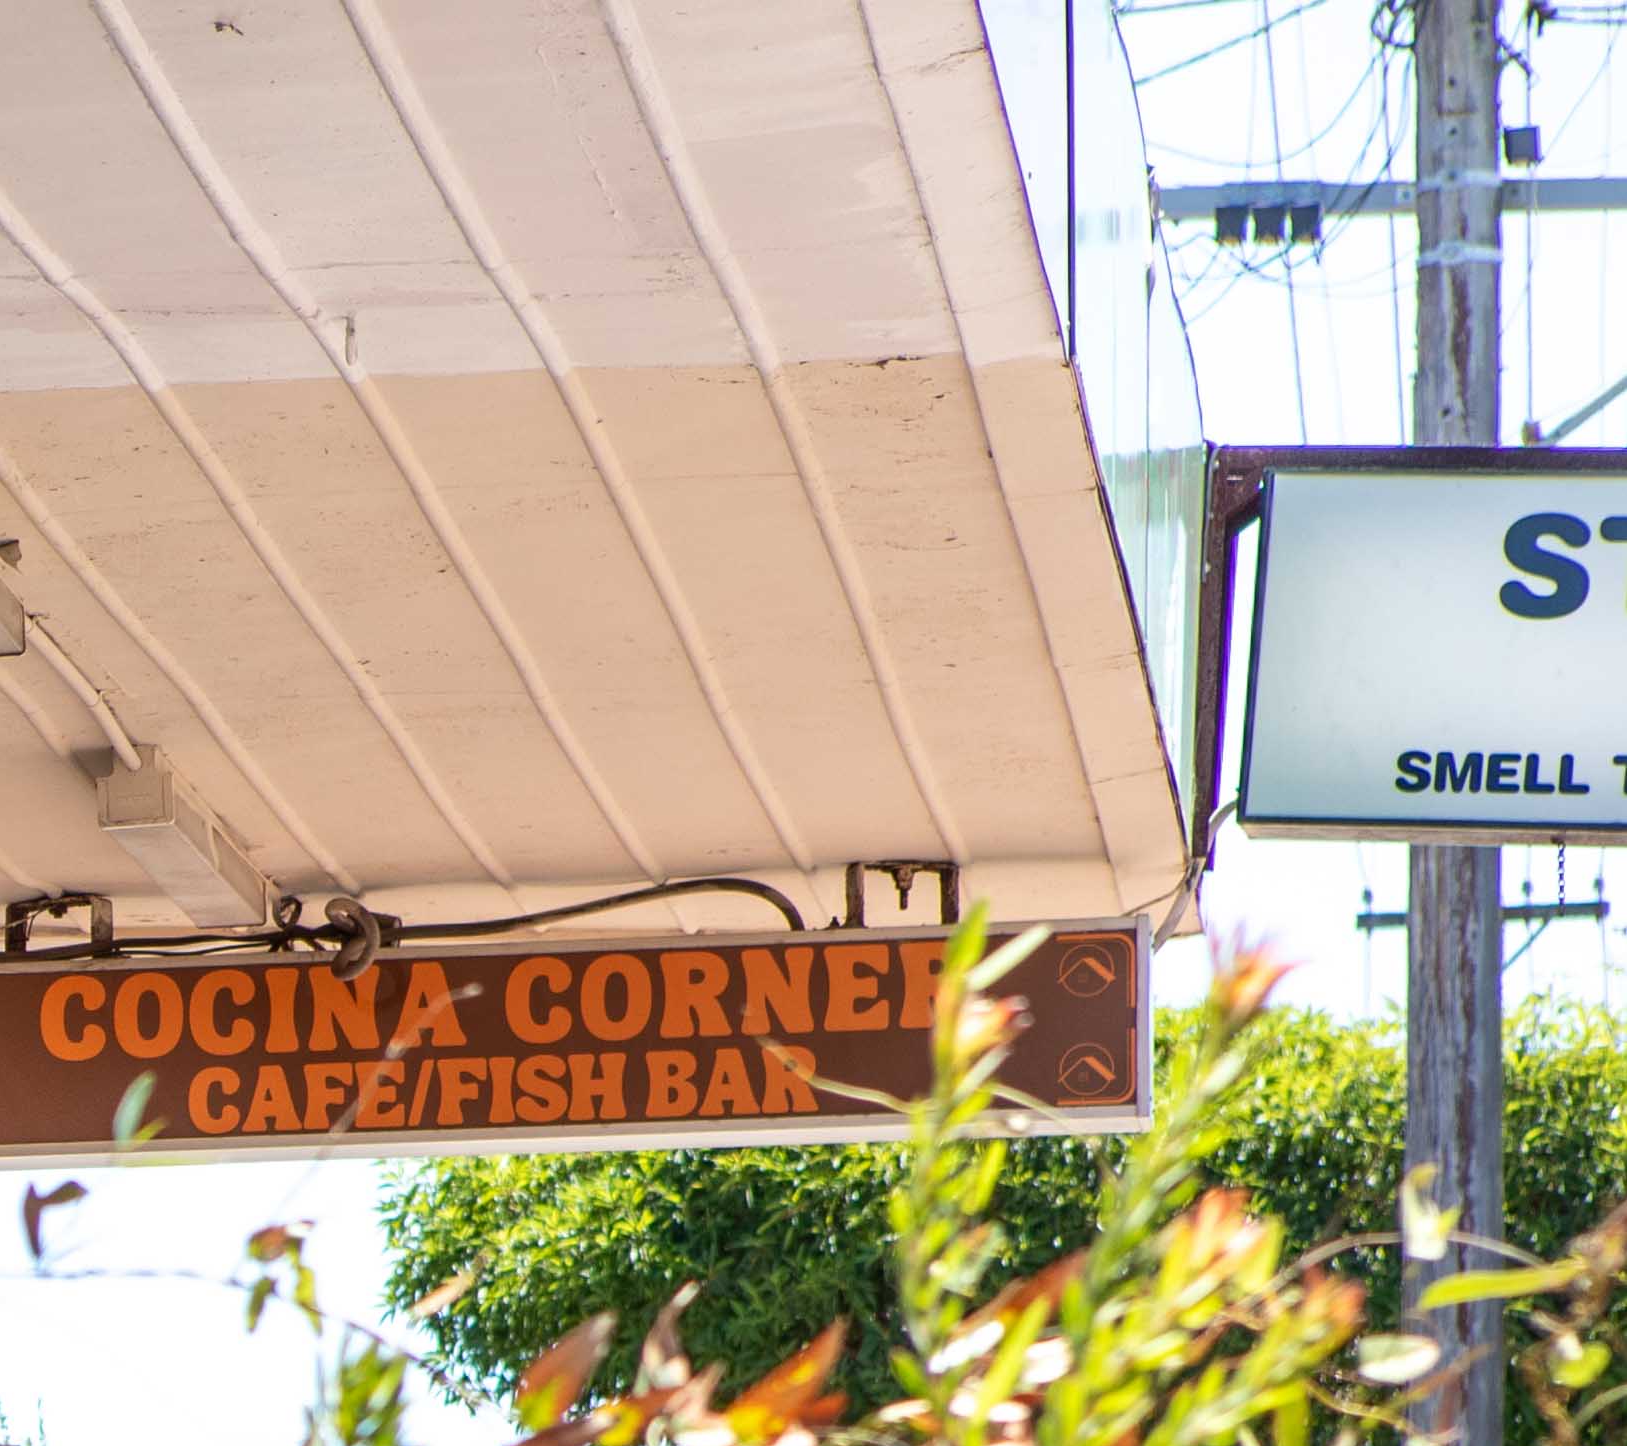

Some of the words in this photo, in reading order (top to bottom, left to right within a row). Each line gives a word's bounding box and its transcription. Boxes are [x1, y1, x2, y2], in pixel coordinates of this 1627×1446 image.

[1498, 512, 1627, 620] S
[1395, 750, 1591, 795] SMELL
[40, 961, 467, 1062] COCINA
[188, 1051, 628, 1134] CAFE/FISH
[645, 1044, 819, 1119] BAR
